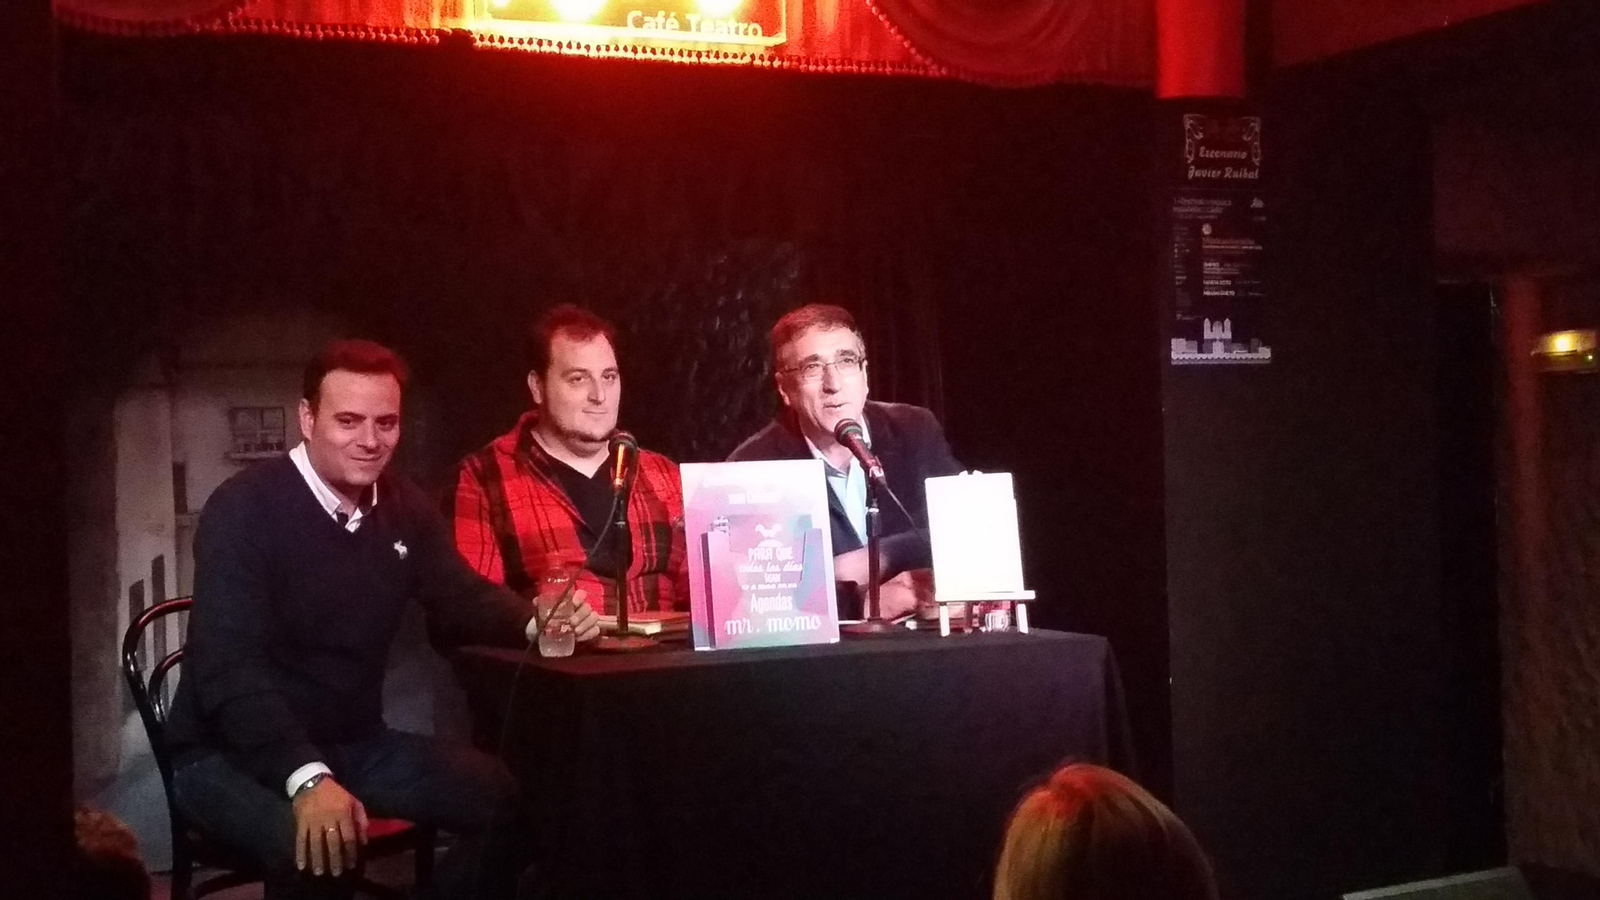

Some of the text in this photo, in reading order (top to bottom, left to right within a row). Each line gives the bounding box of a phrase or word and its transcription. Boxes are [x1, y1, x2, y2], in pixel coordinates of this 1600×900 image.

[627, 10, 763, 37] Café Teatro
[1199, 146, 1248, 159] Escenario
[1188, 165, 1221, 179] Javier
[748, 546, 794, 561] PARA QUE
[750, 593, 793, 614] Agendas
[725, 615, 822, 635] mr. momo
